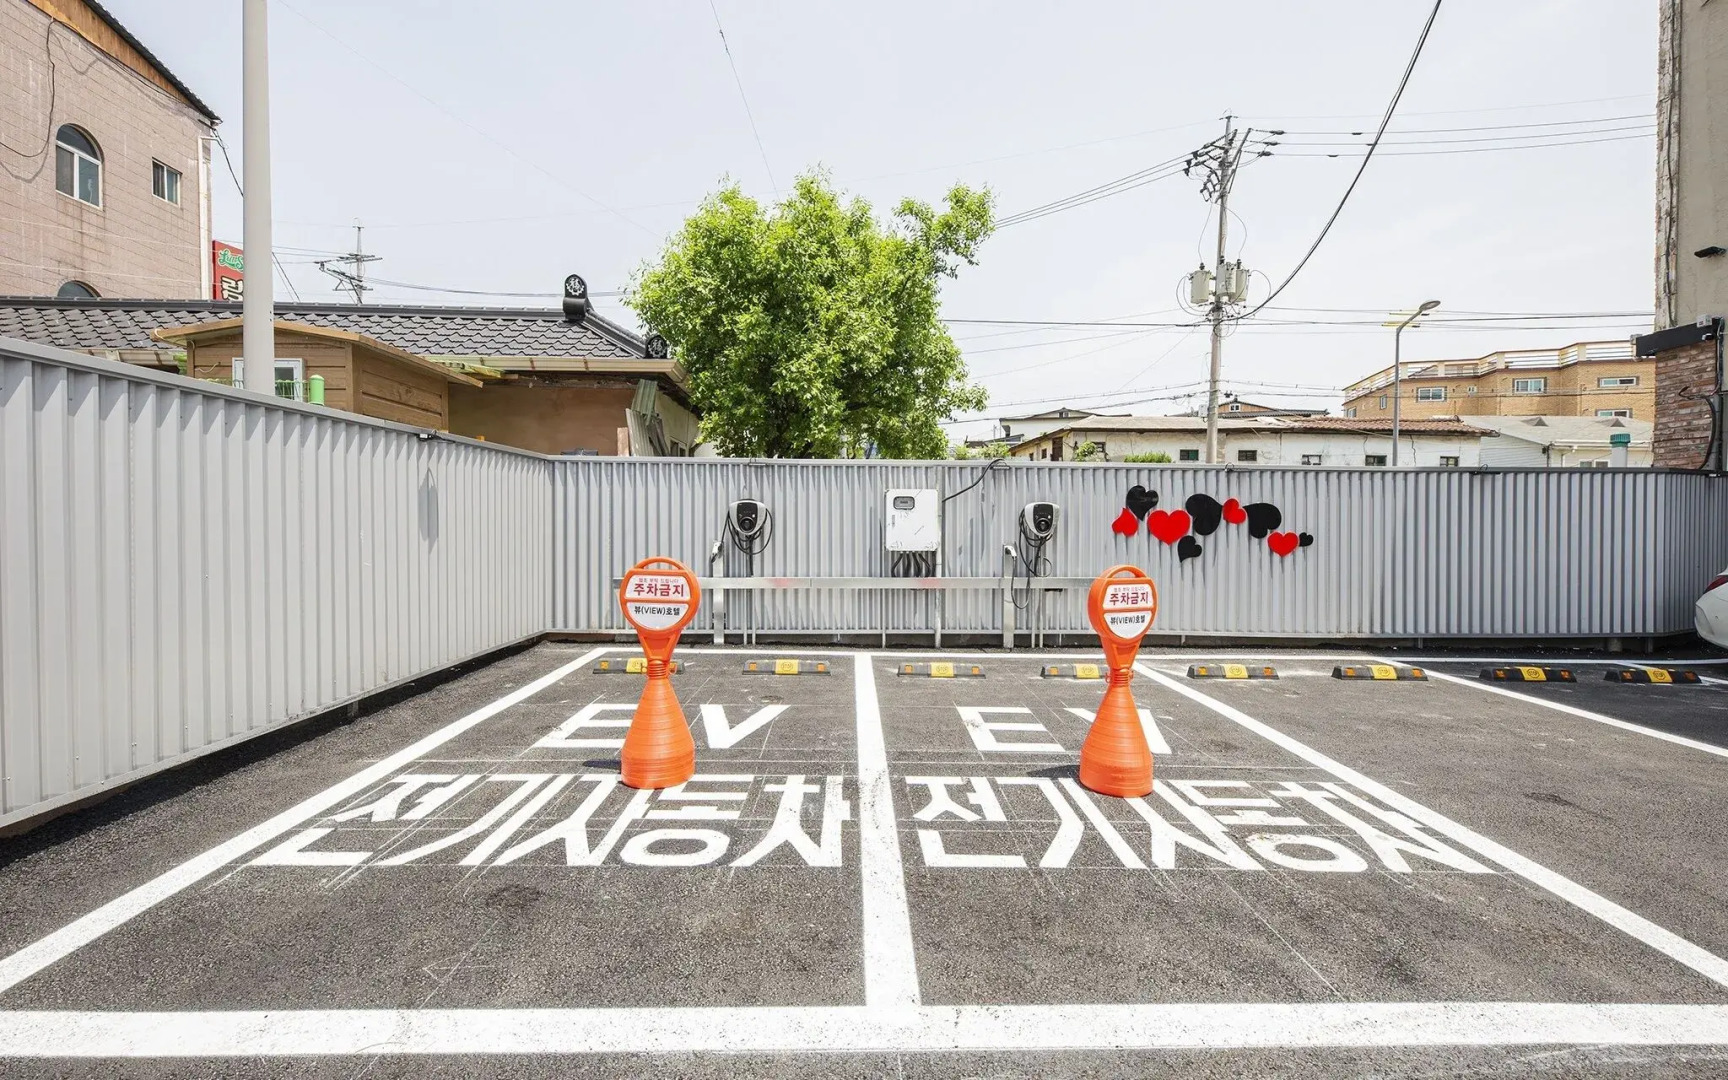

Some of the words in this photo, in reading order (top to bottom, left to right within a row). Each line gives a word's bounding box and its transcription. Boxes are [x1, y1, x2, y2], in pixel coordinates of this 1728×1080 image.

[633, 583, 684, 597] 주차금지
[1109, 592, 1149, 606] 주차금지
[634, 605, 680, 616] 뷰(VIEW)호텔
[534, 703, 792, 749] EV
[250, 773, 852, 868] 전기자동차
[905, 776, 1500, 874] 전기자동차
